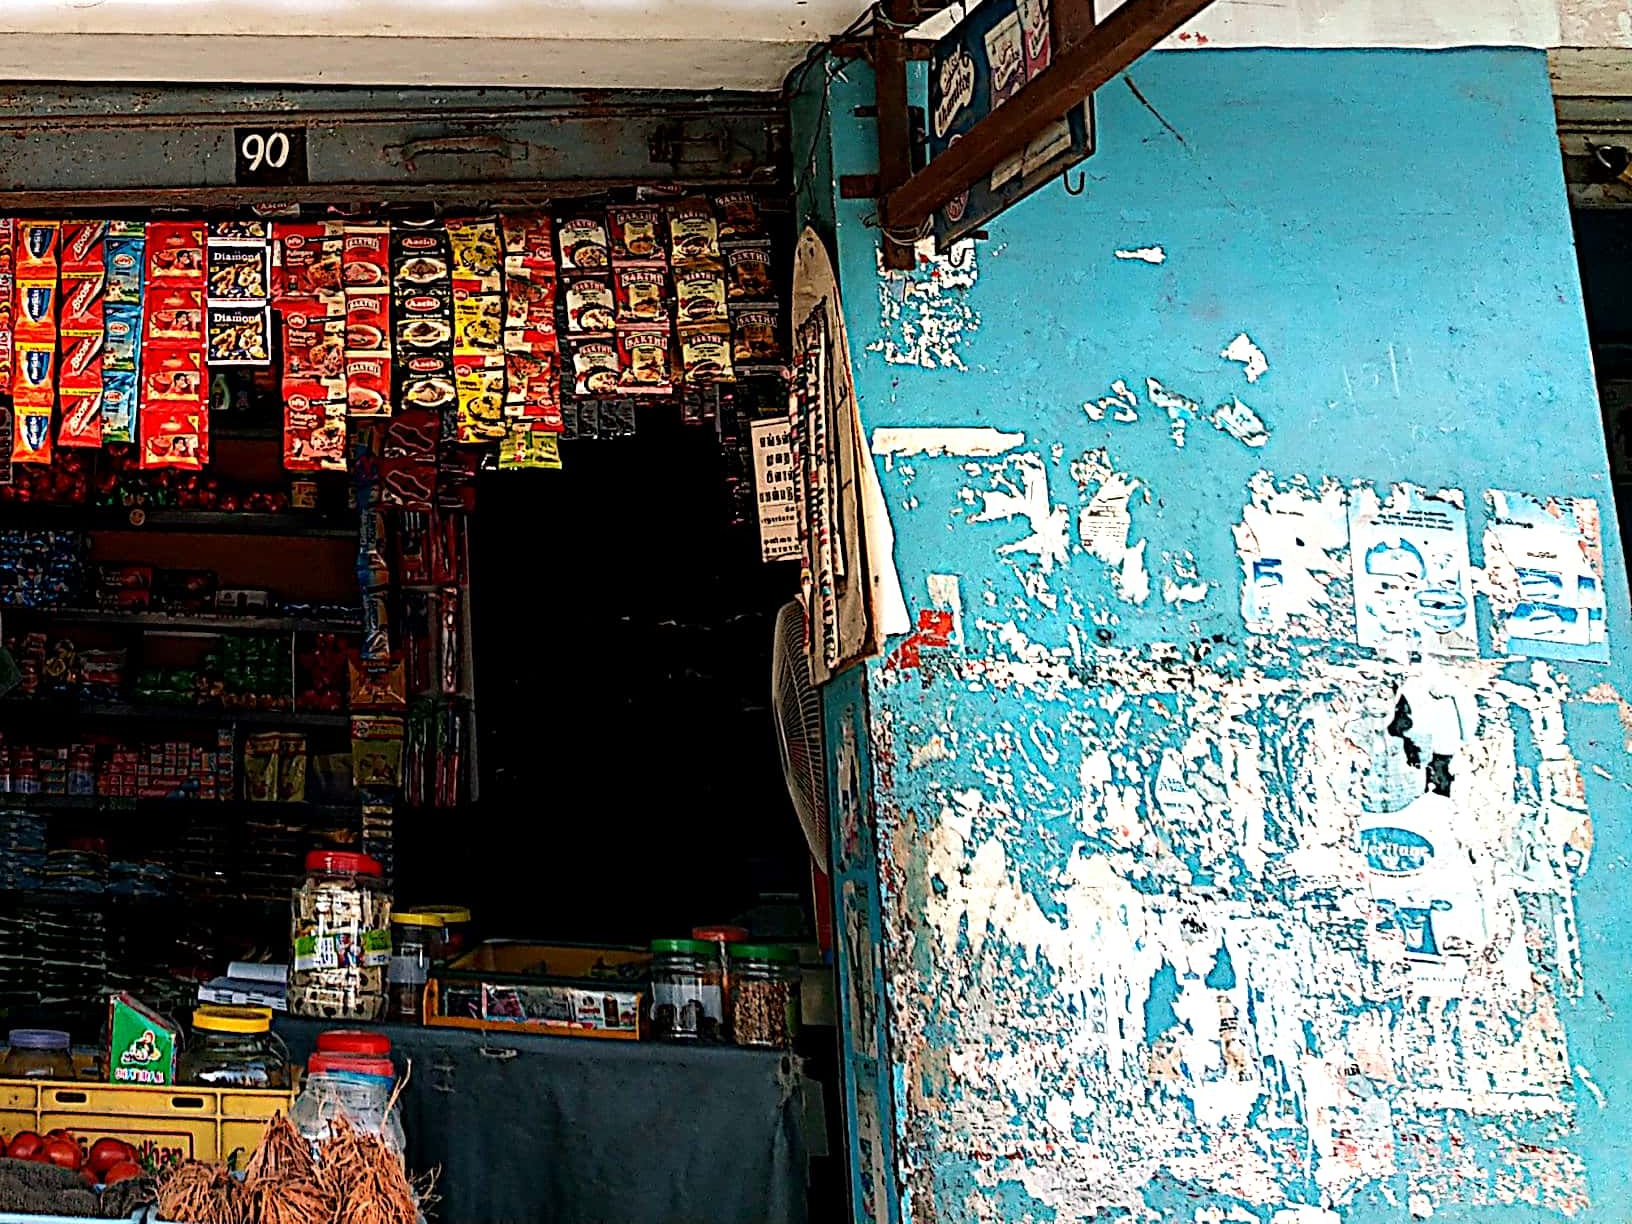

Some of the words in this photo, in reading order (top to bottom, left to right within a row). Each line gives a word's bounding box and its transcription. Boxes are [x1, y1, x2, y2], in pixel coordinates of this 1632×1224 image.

[241, 132, 289, 171] 90
[214, 252, 261, 262] Diamond
[214, 313, 261, 323] Diamond
